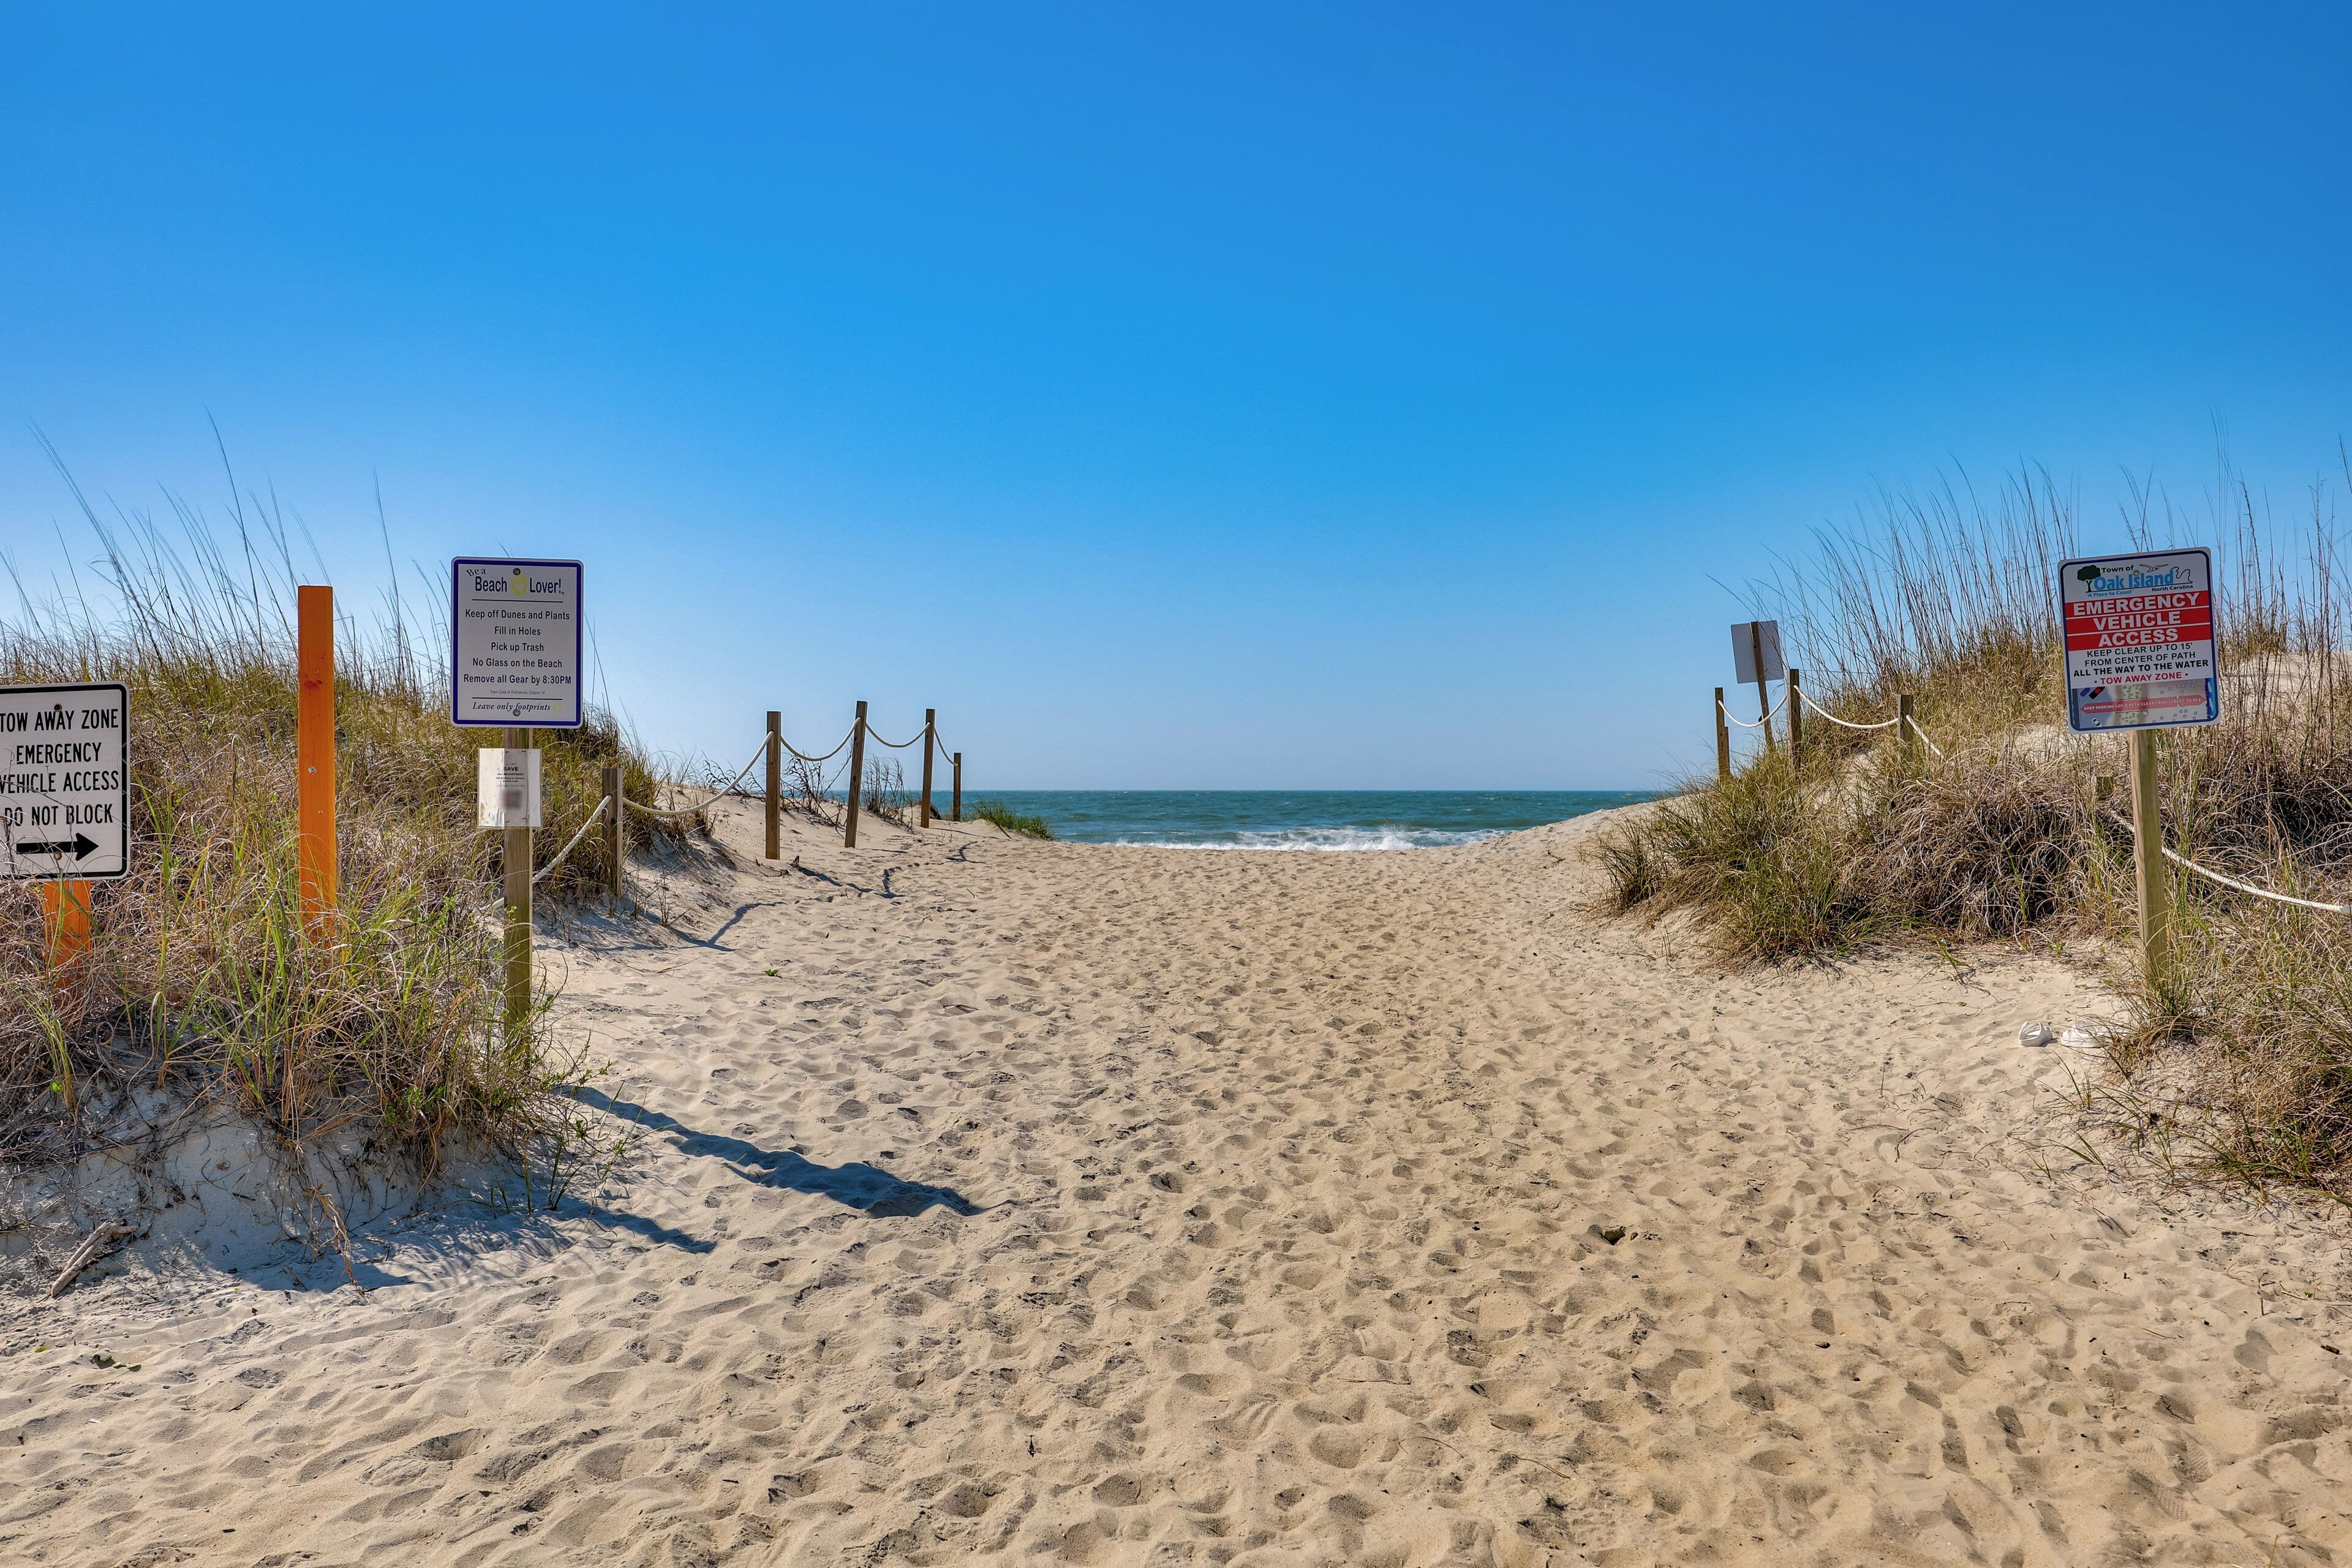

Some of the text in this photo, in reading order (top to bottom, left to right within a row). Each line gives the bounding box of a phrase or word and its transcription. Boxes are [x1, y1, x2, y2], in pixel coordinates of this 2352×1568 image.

[466, 568, 480, 577] Be
[475, 576, 561, 594] Beach Lover!
[2094, 570, 2174, 591] Oak Island
[2073, 592, 2200, 616] EMERGENCY
[465, 609, 570, 620] Keep off Dunes and Plants
[2093, 611, 2181, 630] VEHICLE
[494, 626, 507, 635] Fill
[519, 627, 541, 635] Holes
[2098, 628, 2179, 647] ACCESS
[491, 642, 544, 653] Pick up Trash
[2114, 646, 2146, 655] CLEAR
[473, 658, 483, 666] No
[486, 658, 508, 667] Glass
[538, 659, 562, 668] Beach
[2114, 656, 2154, 665] CENTER
[2115, 666, 2136, 674] WAY
[2176, 659, 2209, 669] WATER
[464, 674, 494, 683] Remove
[509, 675, 529, 684] Gear
[531, 675, 540, 685] by
[543, 676, 571, 684] 8:30PM
[2125, 674, 2153, 683] AWAY
[2155, 671, 2182, 680] ZONE
[497, 703, 513, 712] only
[514, 703, 551, 712] footprints
[0, 709, 119, 733] TOW AWAY ZONE
[16, 742, 102, 764] EMERGENCY
[0, 770, 119, 794] VEHICLE ACCESS
[4, 804, 113, 827] DO NOT BLOCK
